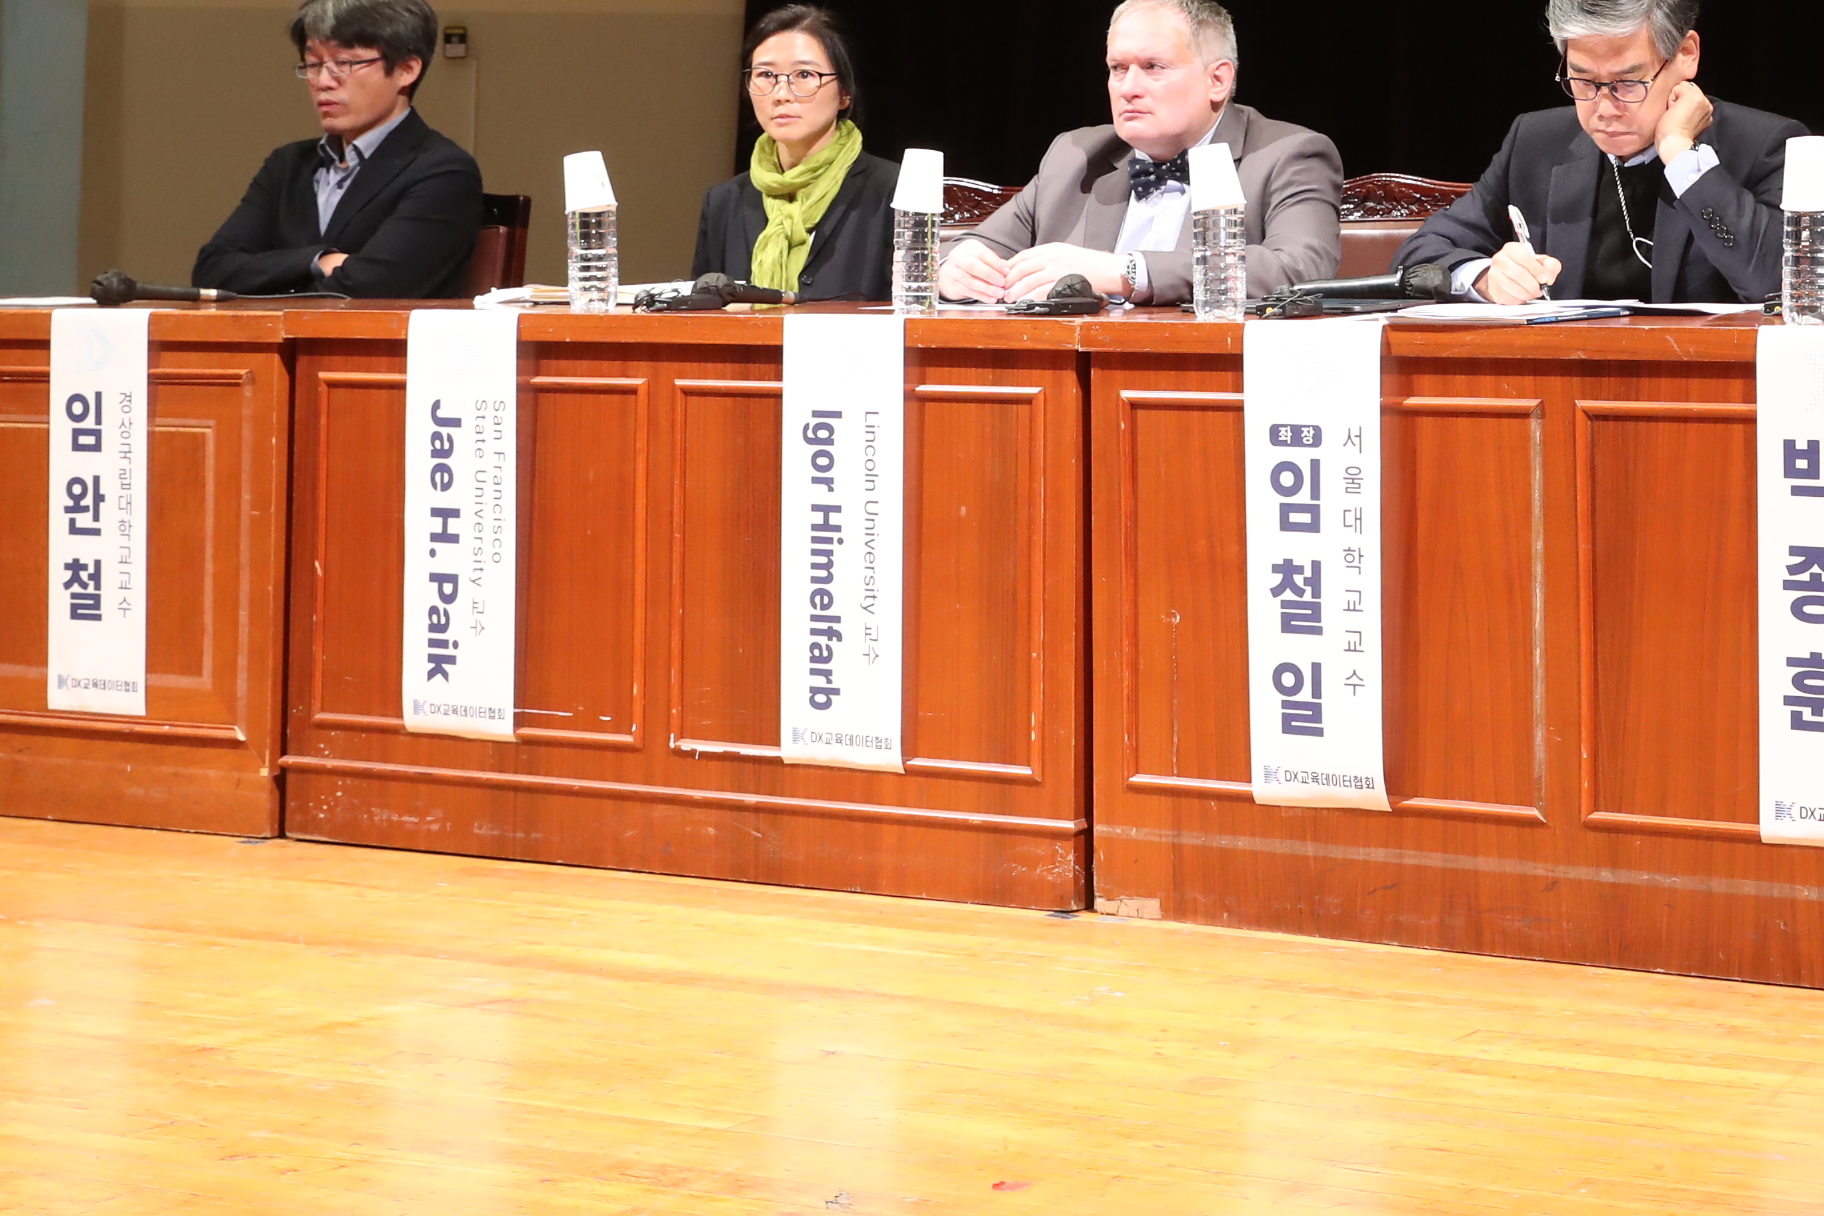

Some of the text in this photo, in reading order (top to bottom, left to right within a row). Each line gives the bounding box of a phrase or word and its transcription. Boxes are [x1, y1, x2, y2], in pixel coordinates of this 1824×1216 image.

[62, 390, 106, 622] 임완철
[426, 398, 462, 683] Jae H. Paik
[469, 399, 488, 636] State University 교수
[491, 400, 506, 564] San Francisco
[859, 411, 880, 665] Lincoln University 교수
[1277, 425, 1316, 445] 좌장
[802, 409, 845, 711] Igor Himelfarb
[1269, 458, 1325, 738] 임철일
[810, 731, 892, 751] DX교육데이터협회
[1284, 769, 1376, 791] DX교육데이터협회
